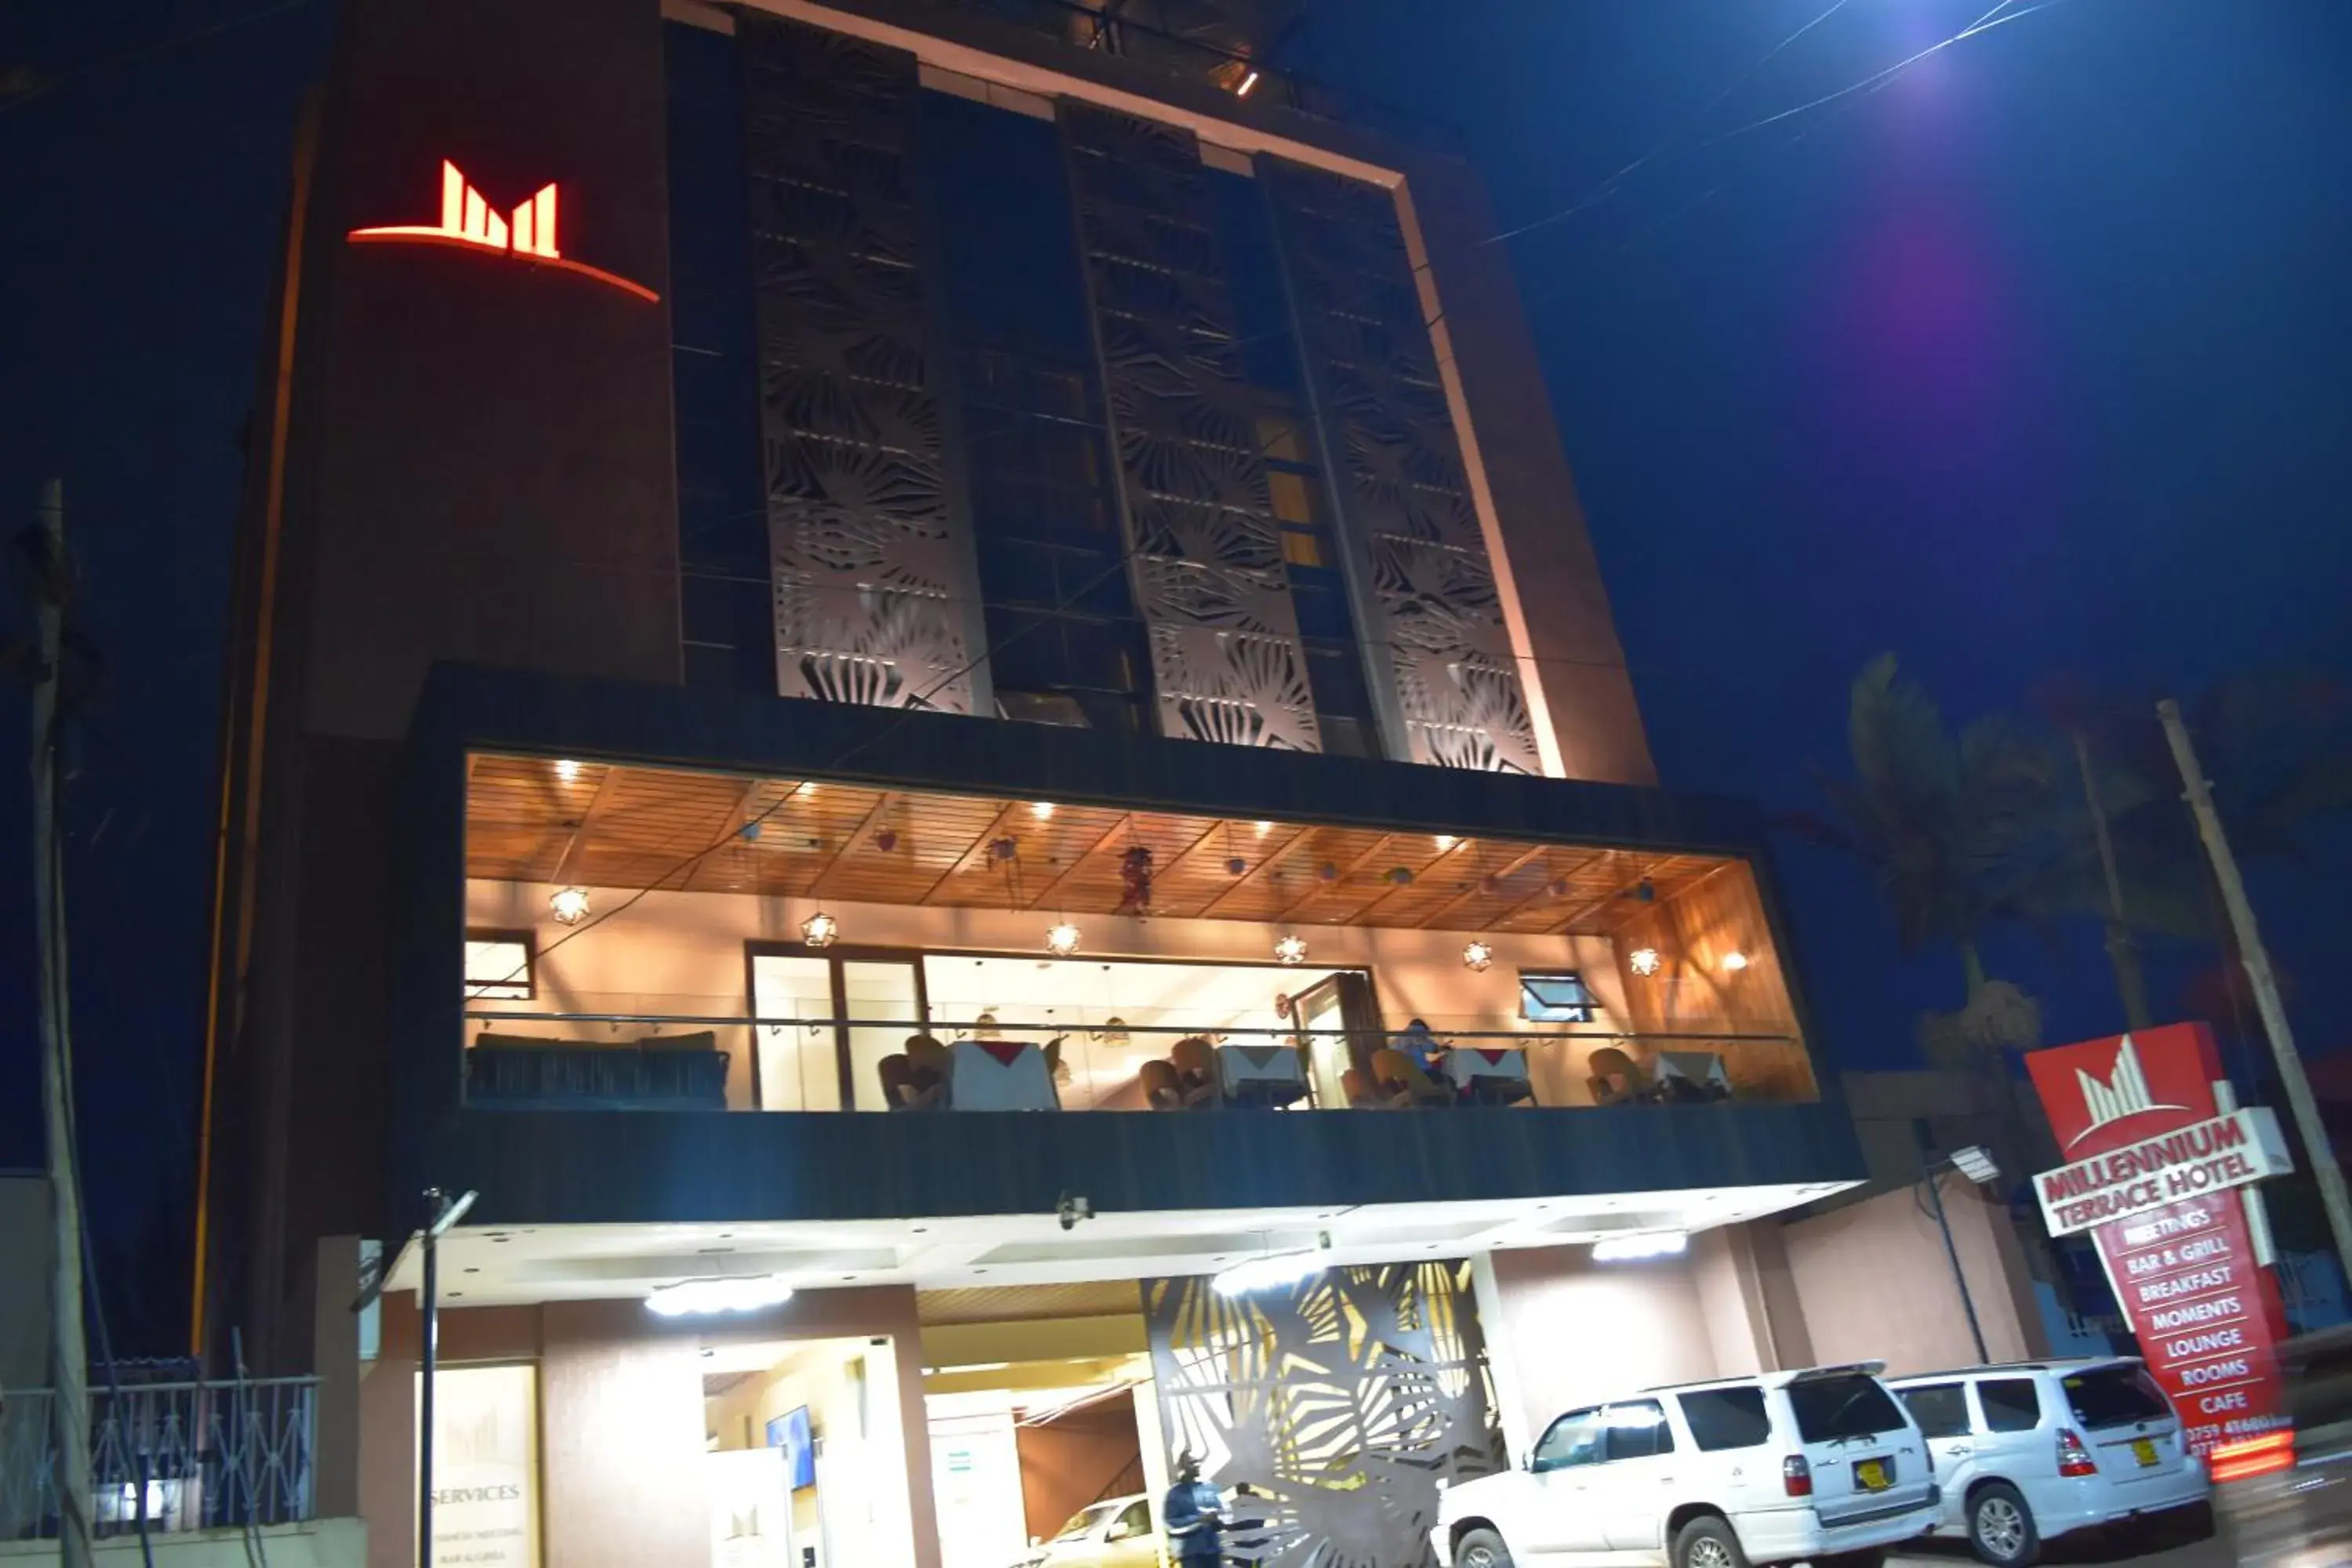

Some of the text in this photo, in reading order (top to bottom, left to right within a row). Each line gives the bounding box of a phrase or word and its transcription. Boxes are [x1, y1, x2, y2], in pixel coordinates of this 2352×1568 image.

[2043, 1116, 2247, 1203] MILLENNIUM
[2053, 1152, 2256, 1228] TERRACE HOTEL
[2126, 1237, 2231, 1274] BAR & GRILL
[2139, 1267, 2231, 1301] BREAKFAST
[2151, 1297, 2241, 1330] MOMENTS
[2166, 1329, 2243, 1357] LOUNGE
[2180, 1359, 2249, 1386] ROOMS
[2199, 1392, 2248, 1414] CAFE
[430, 1483, 521, 1506] SERVICES
